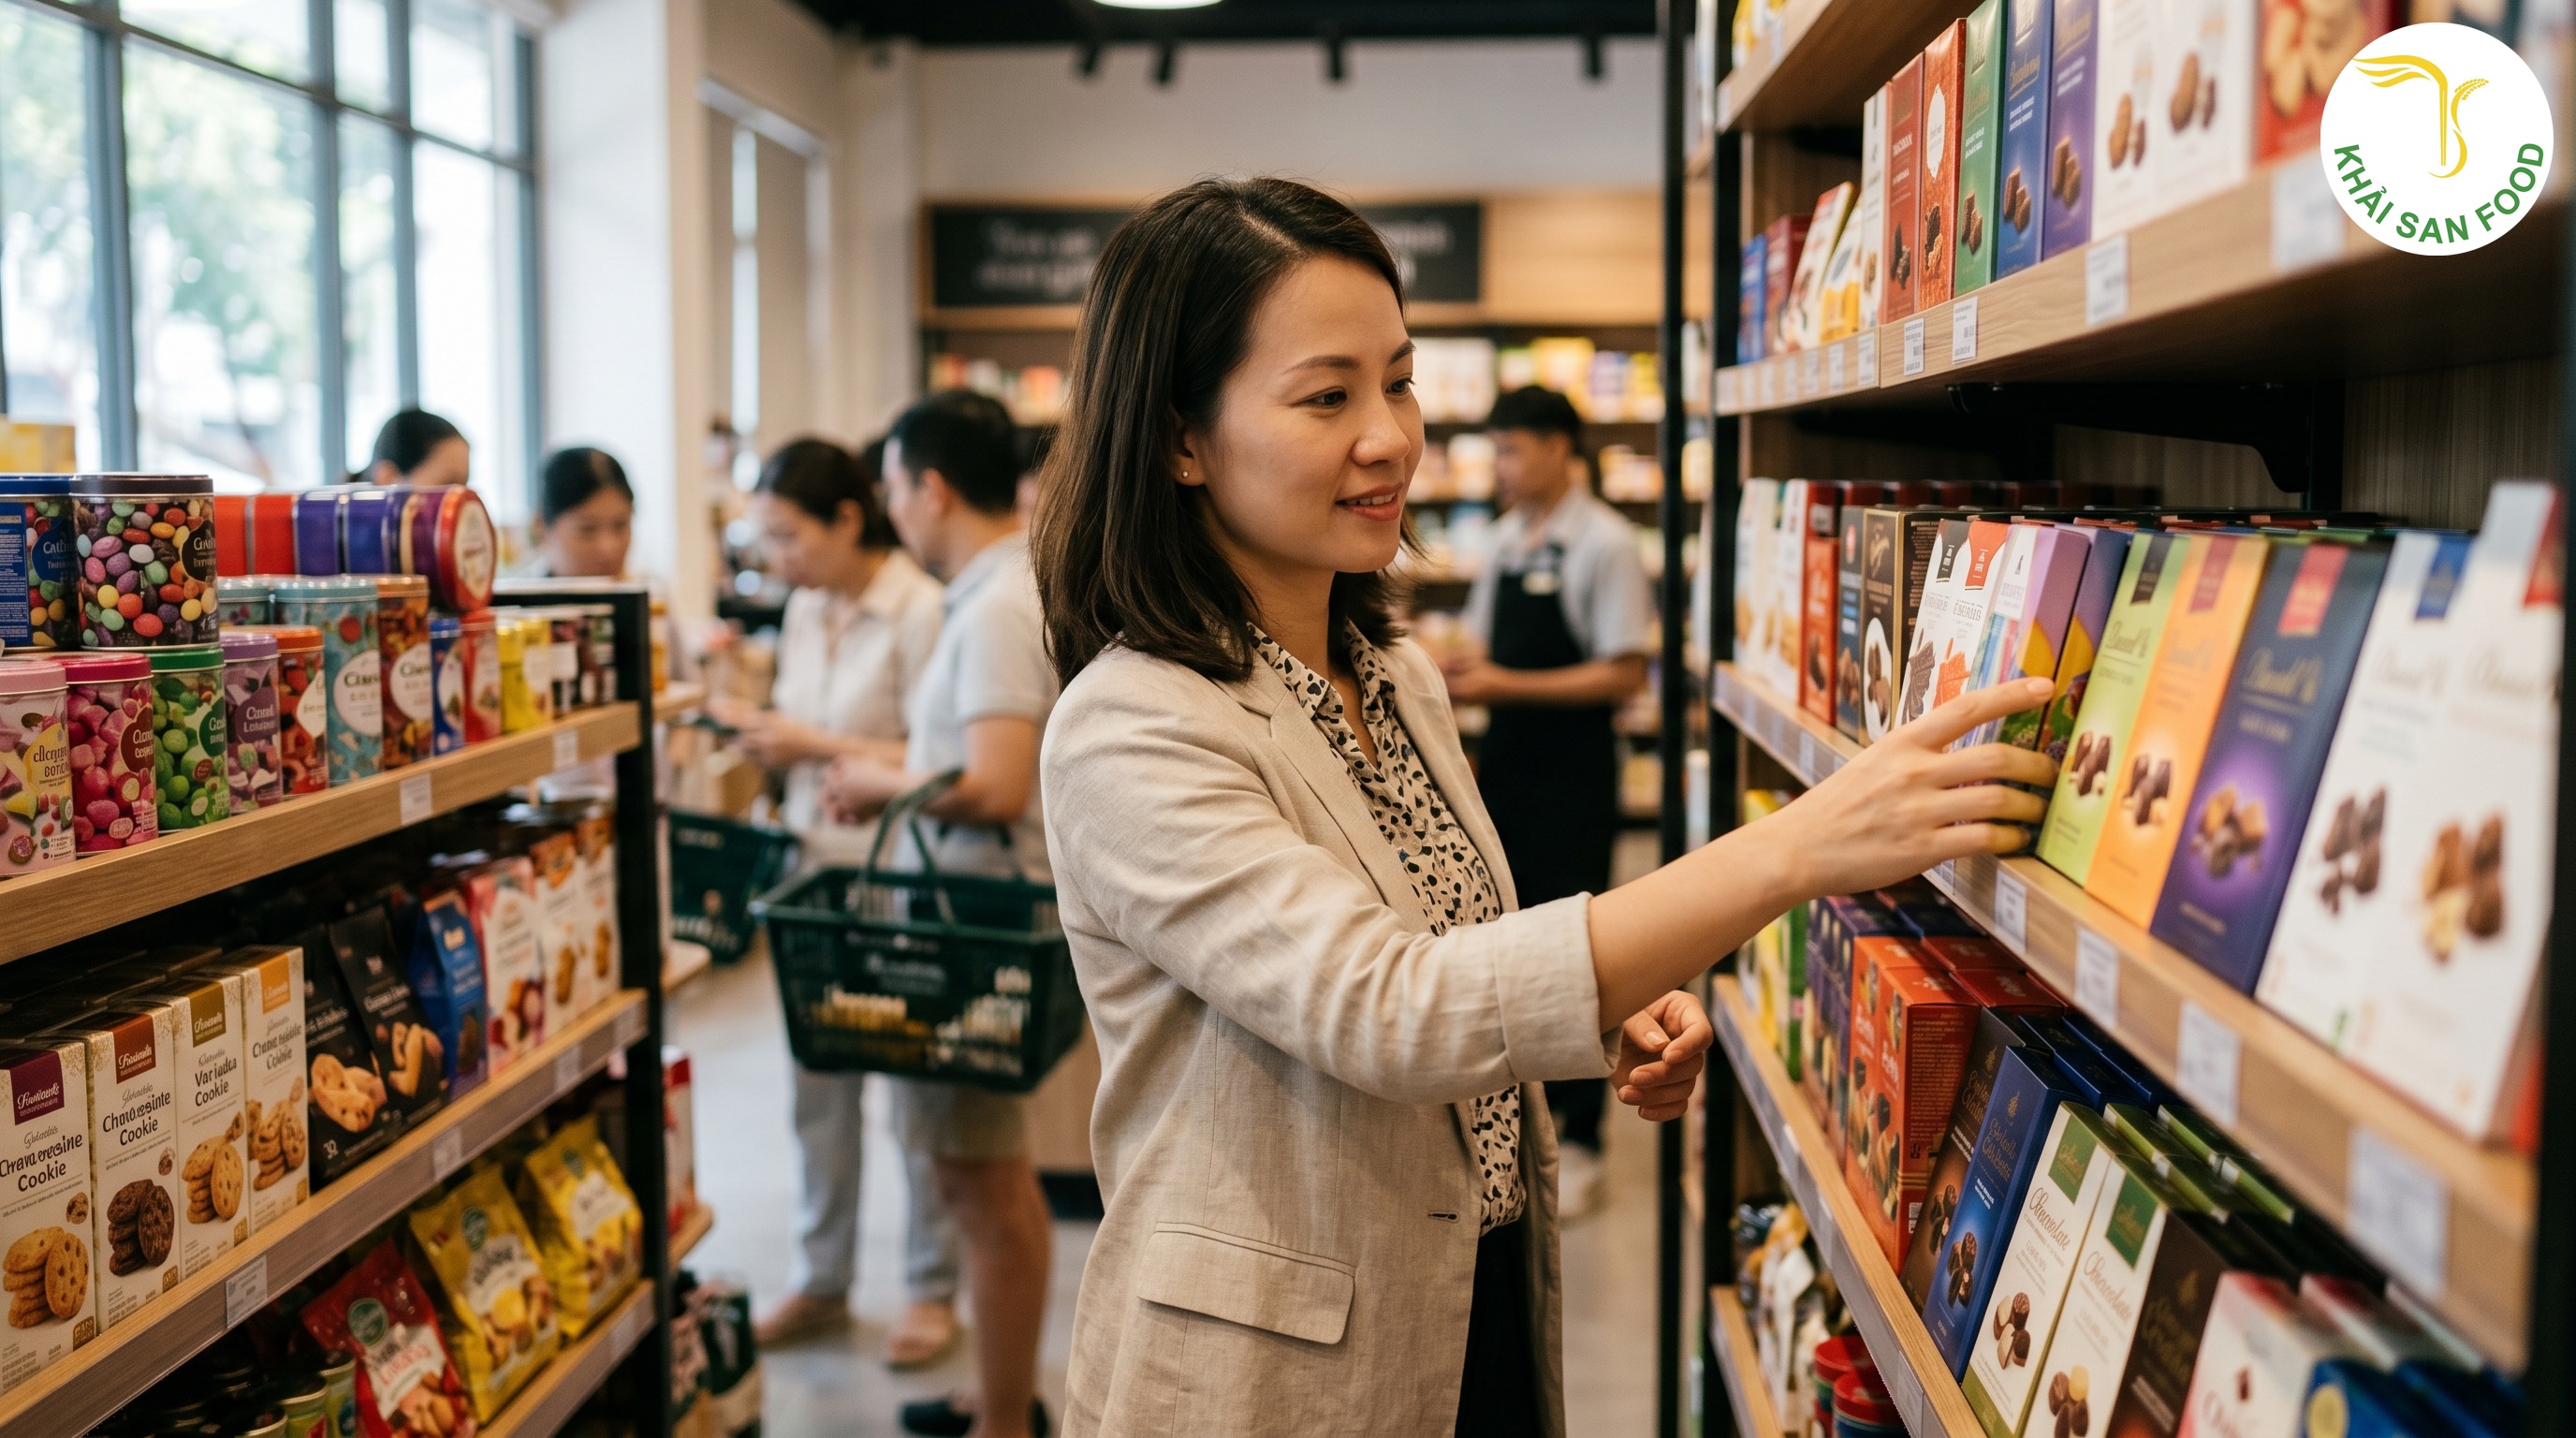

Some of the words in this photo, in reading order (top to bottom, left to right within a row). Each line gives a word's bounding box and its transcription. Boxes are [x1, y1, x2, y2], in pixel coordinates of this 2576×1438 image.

[195, 1079, 228, 1107] Cookie
[120, 1116, 158, 1146] Cookie
[18, 1162, 66, 1192] Cookie
